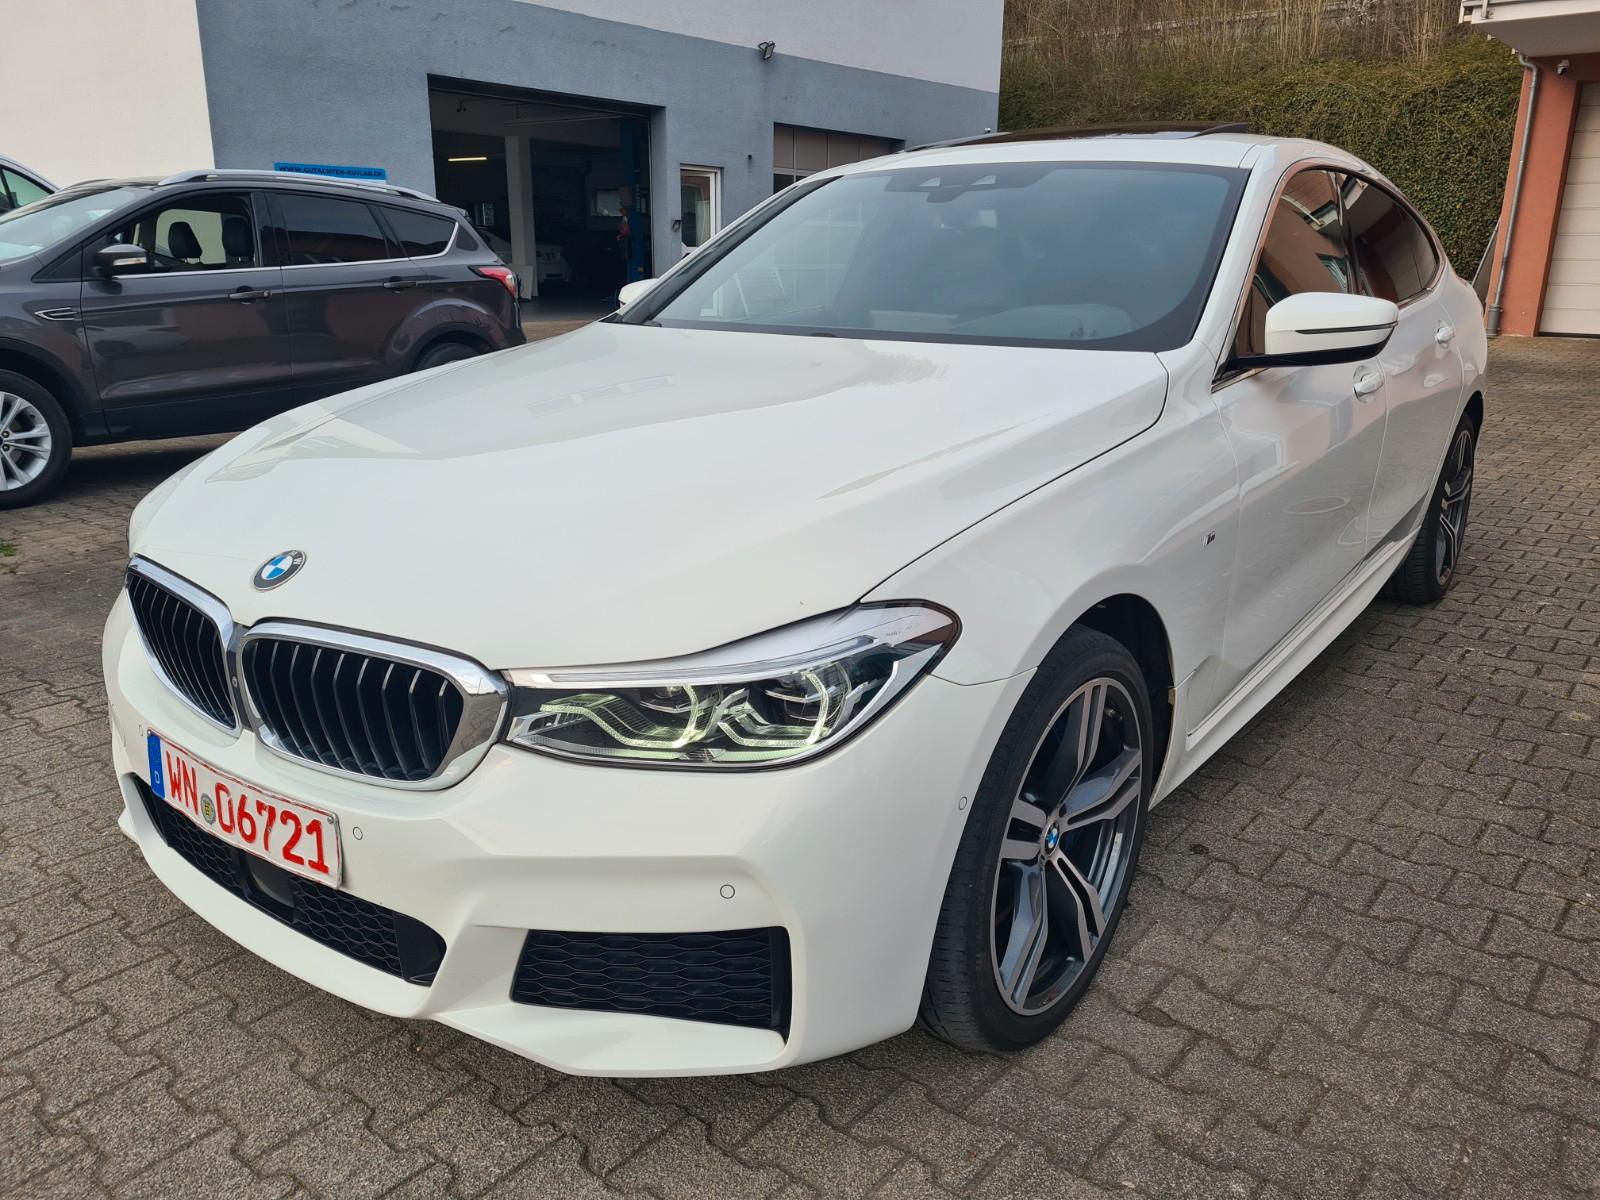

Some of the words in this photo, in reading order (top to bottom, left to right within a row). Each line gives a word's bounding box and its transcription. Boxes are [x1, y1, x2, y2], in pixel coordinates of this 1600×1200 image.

[154, 770, 161, 784] D
[166, 750, 199, 815] WN
[214, 782, 329, 875] 06721
